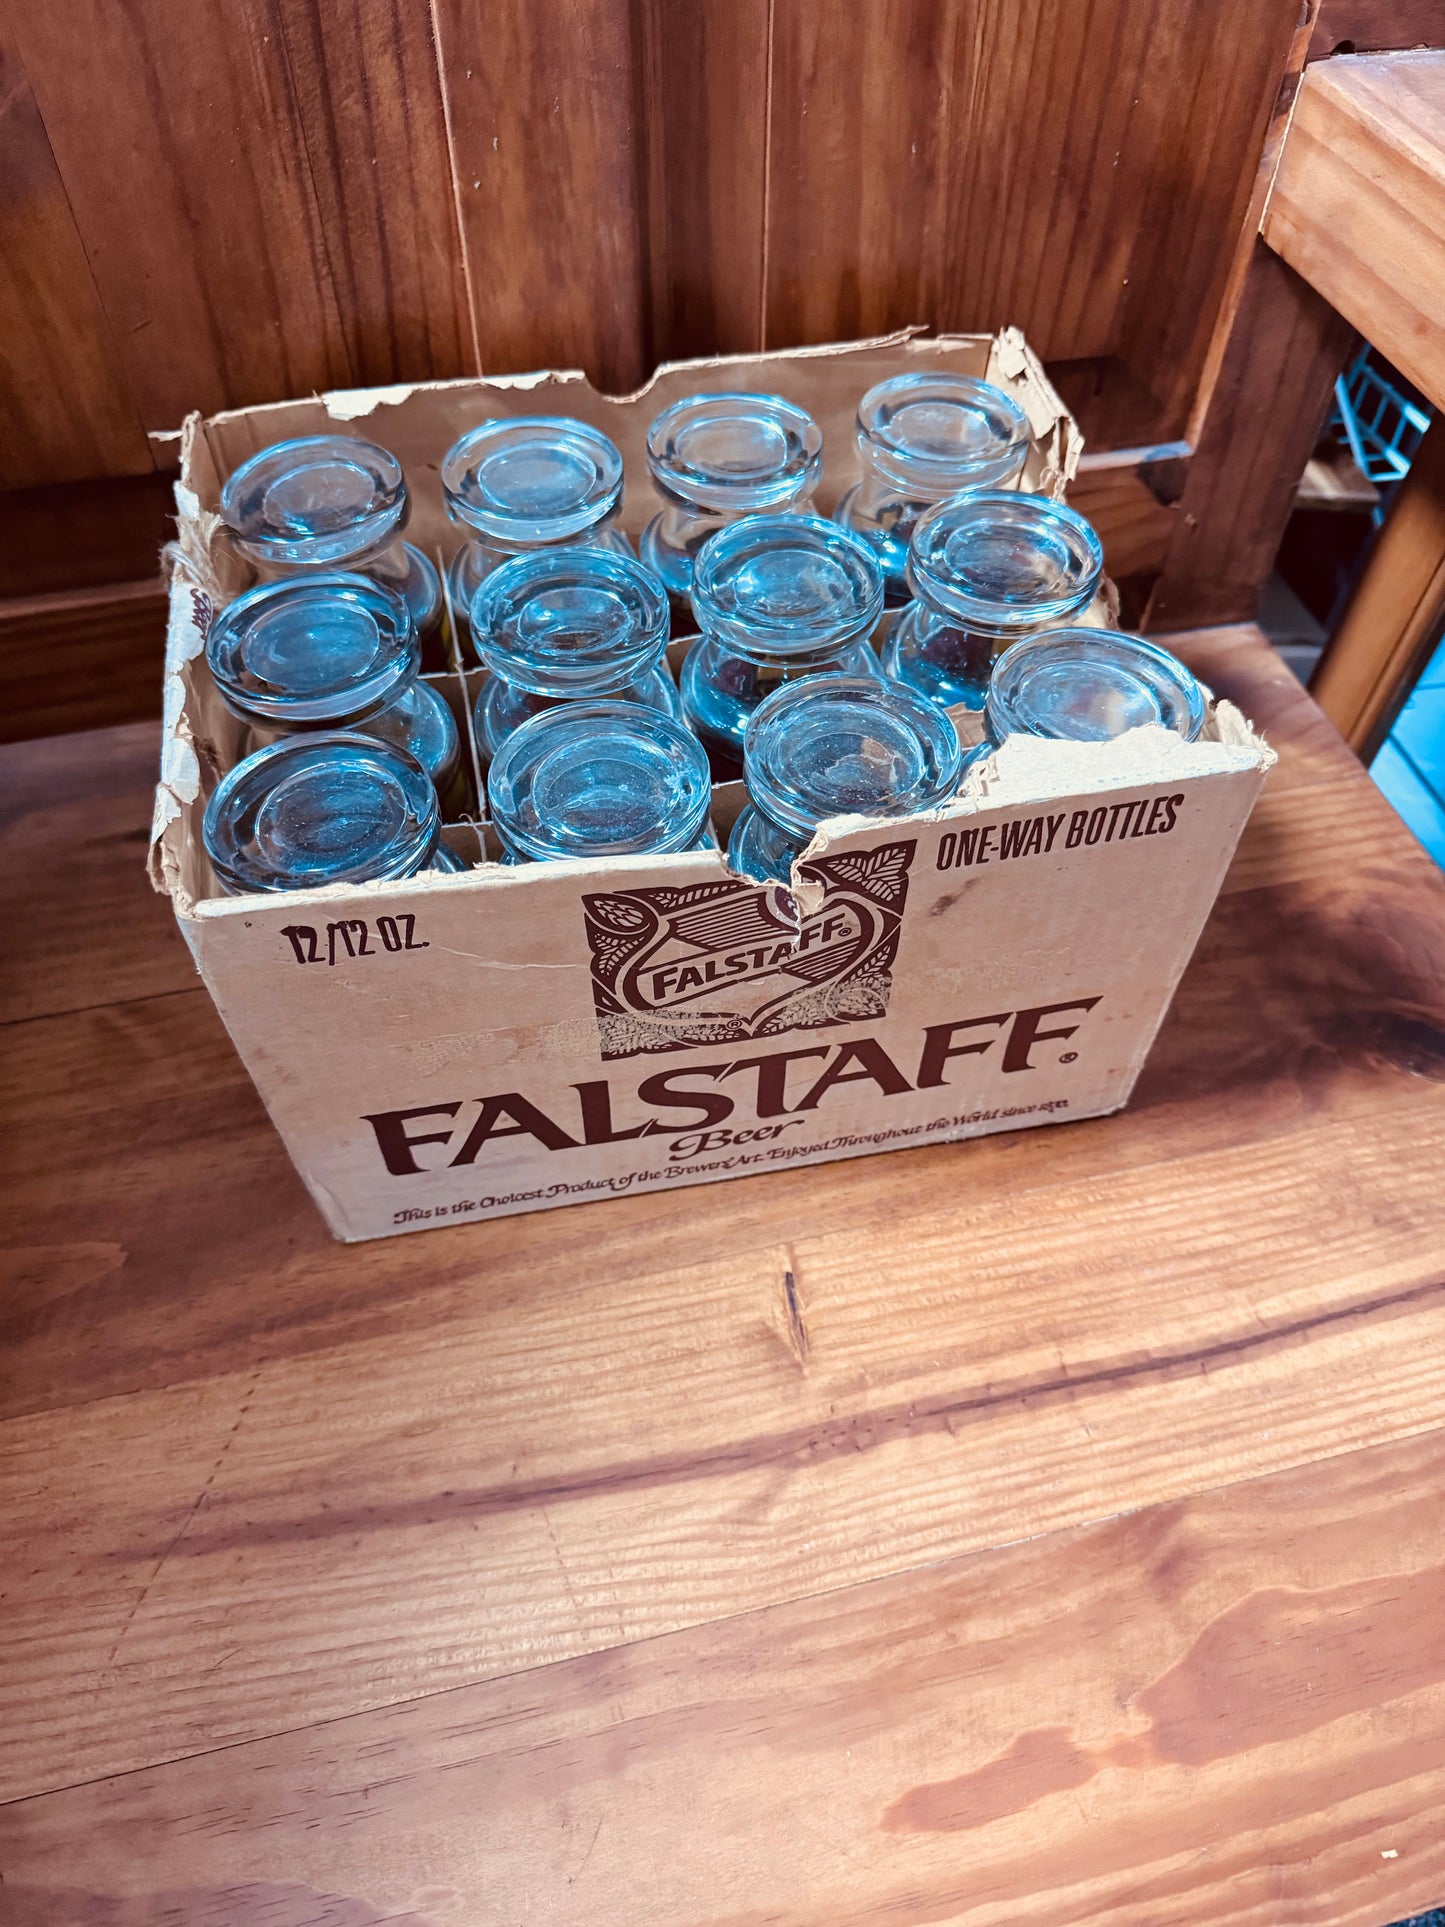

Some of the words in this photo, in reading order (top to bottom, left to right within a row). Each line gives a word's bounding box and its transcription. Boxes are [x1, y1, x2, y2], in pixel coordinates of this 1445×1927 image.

[936, 813, 1066, 870] ONE-WAY
[1065, 794, 1185, 849] BOTTLES
[279, 919, 376, 966] 12/12
[376, 913, 430, 952] OZ.
[359, 995, 1104, 1177] FALSTAFF
[393, 1208, 432, 1225] This
[435, 1206, 448, 1217] is
[452, 1200, 477, 1214] the
[480, 1188, 544, 1209] Choicest
[546, 1177, 616, 1198] Product
[612, 1172, 638, 1191] of
[638, 1170, 662, 1183] the
[766, 1141, 830, 1160] Enjoyed
[831, 1124, 924, 1149] Throughout
[925, 1117, 950, 1131] the
[952, 1108, 1000, 1127] World
[1000, 1104, 1037, 1119] since
[669, 1119, 805, 1161] Beer
